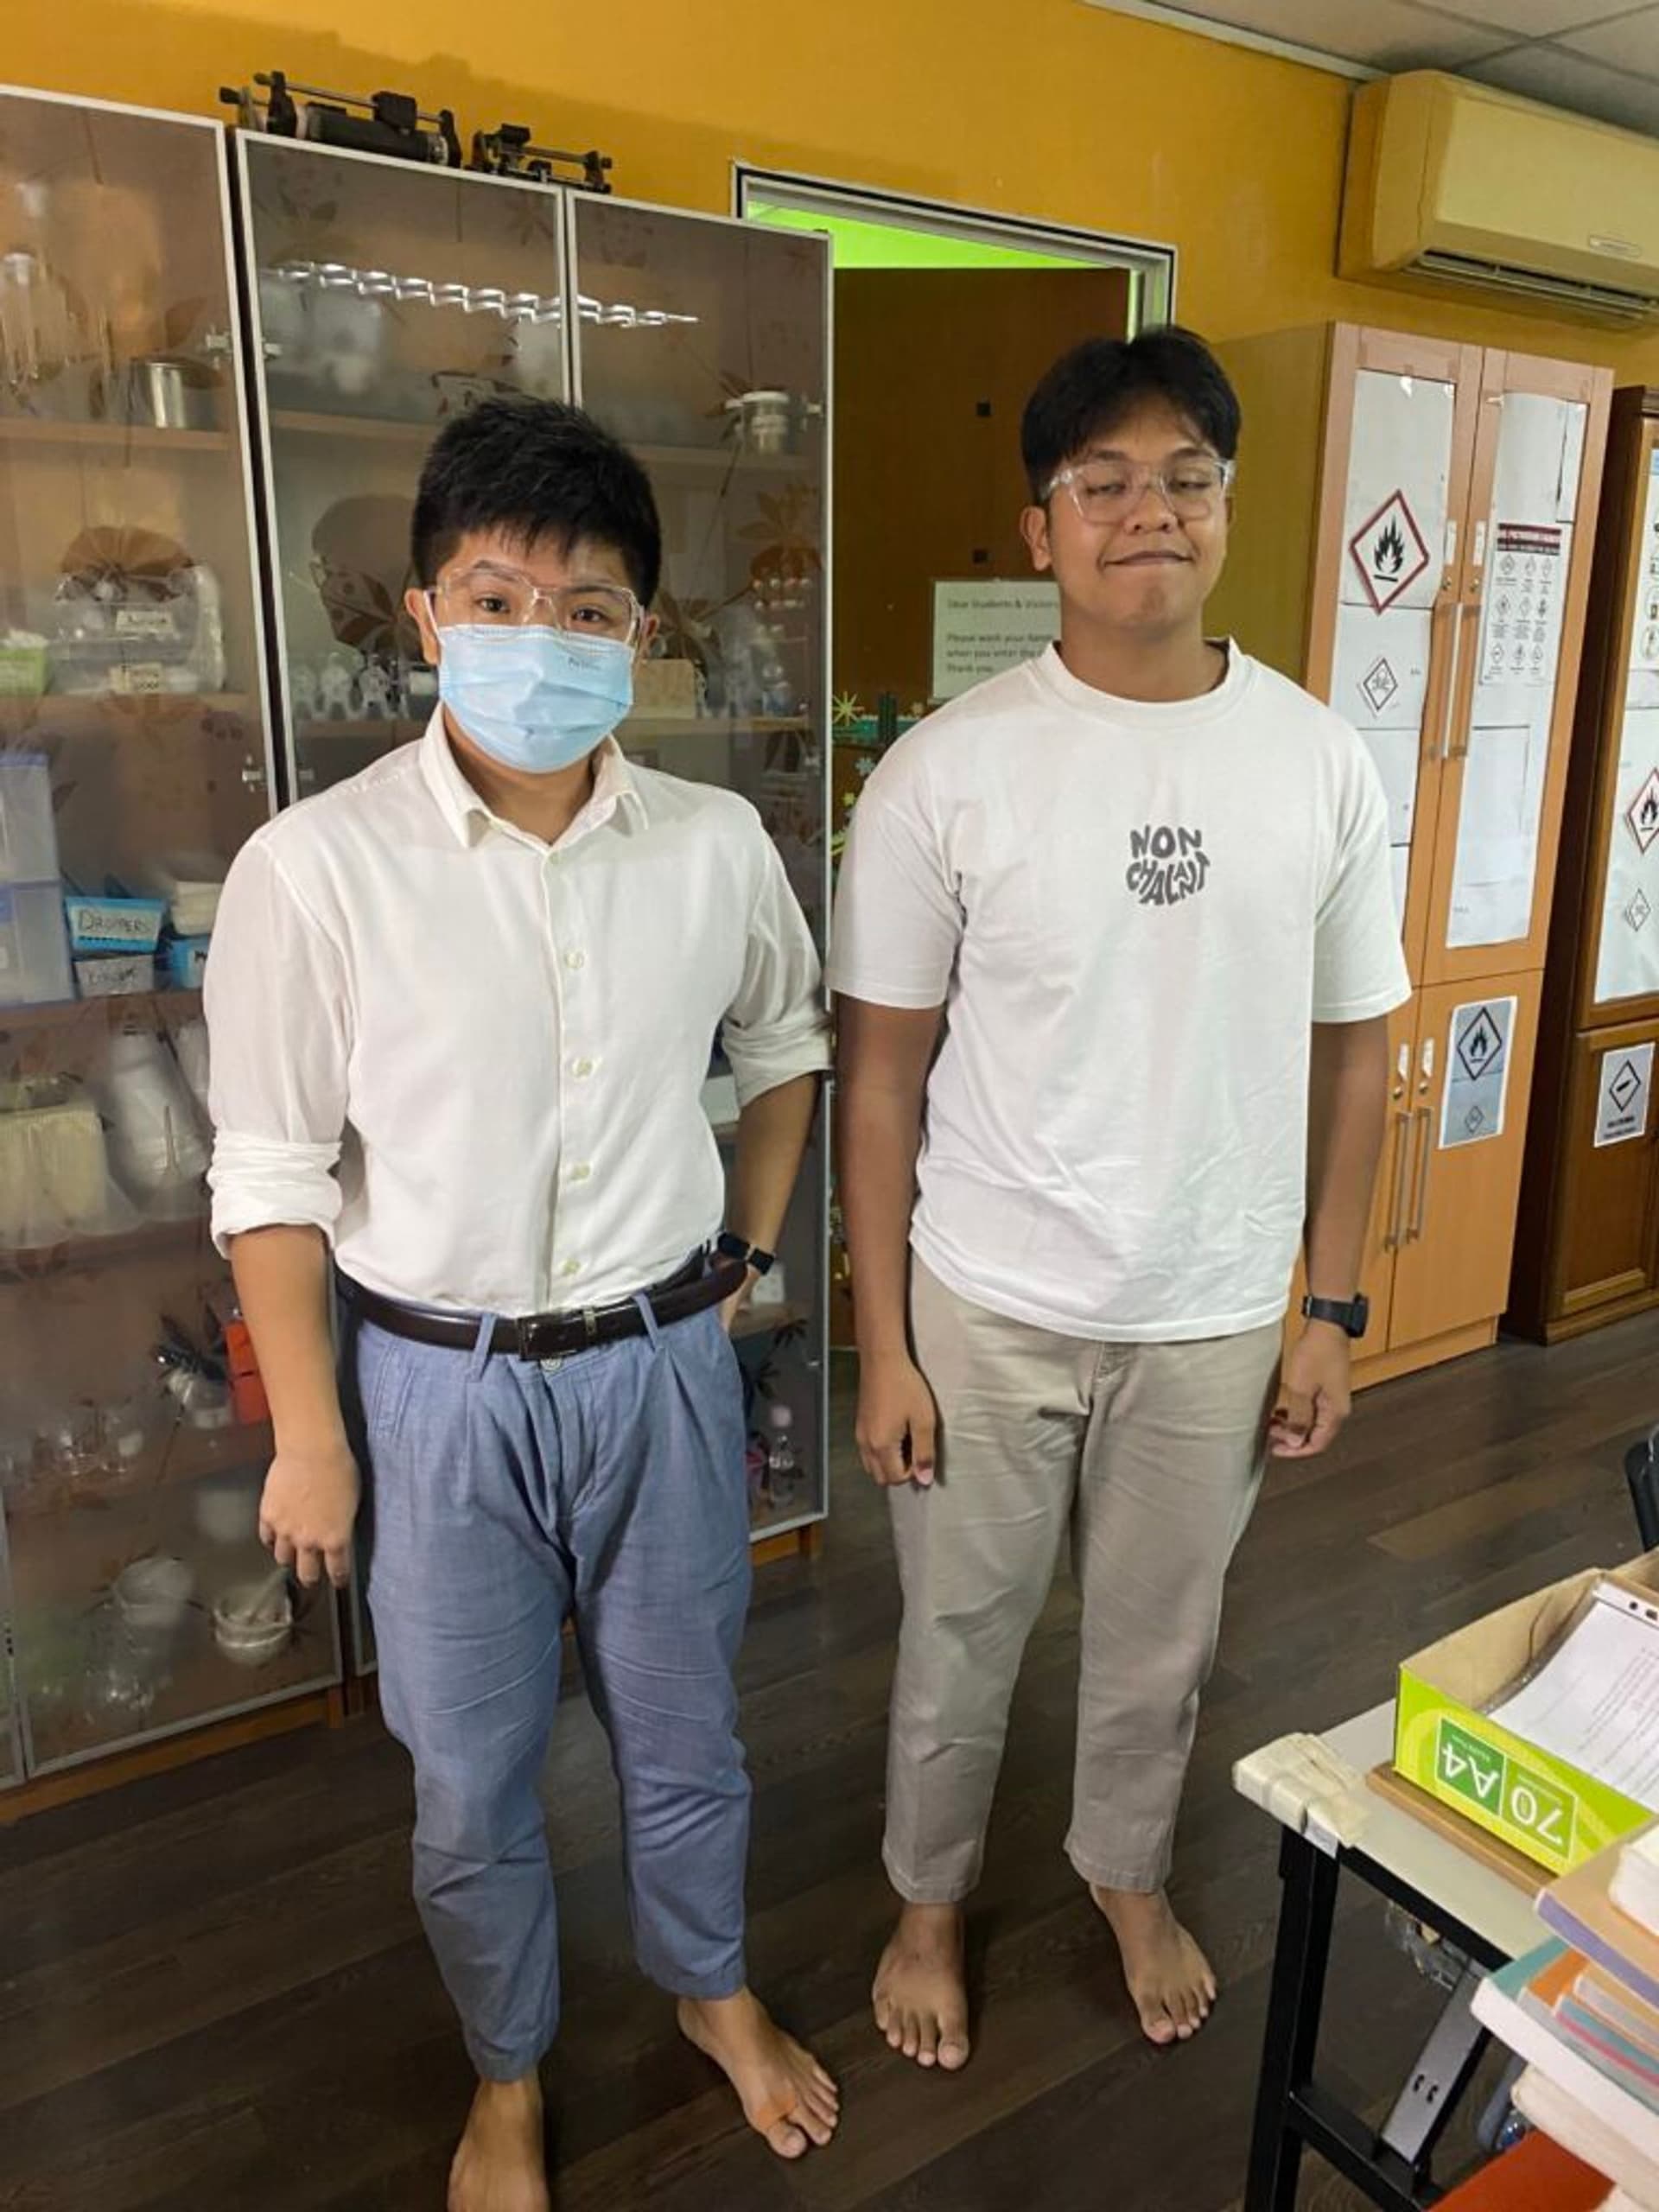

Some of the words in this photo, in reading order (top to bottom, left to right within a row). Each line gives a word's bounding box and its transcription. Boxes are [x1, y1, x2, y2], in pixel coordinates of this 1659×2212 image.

[1130, 823, 1201, 859] NON
[1441, 1742, 1500, 1799] A4
[1511, 1785, 1563, 1846] 70
